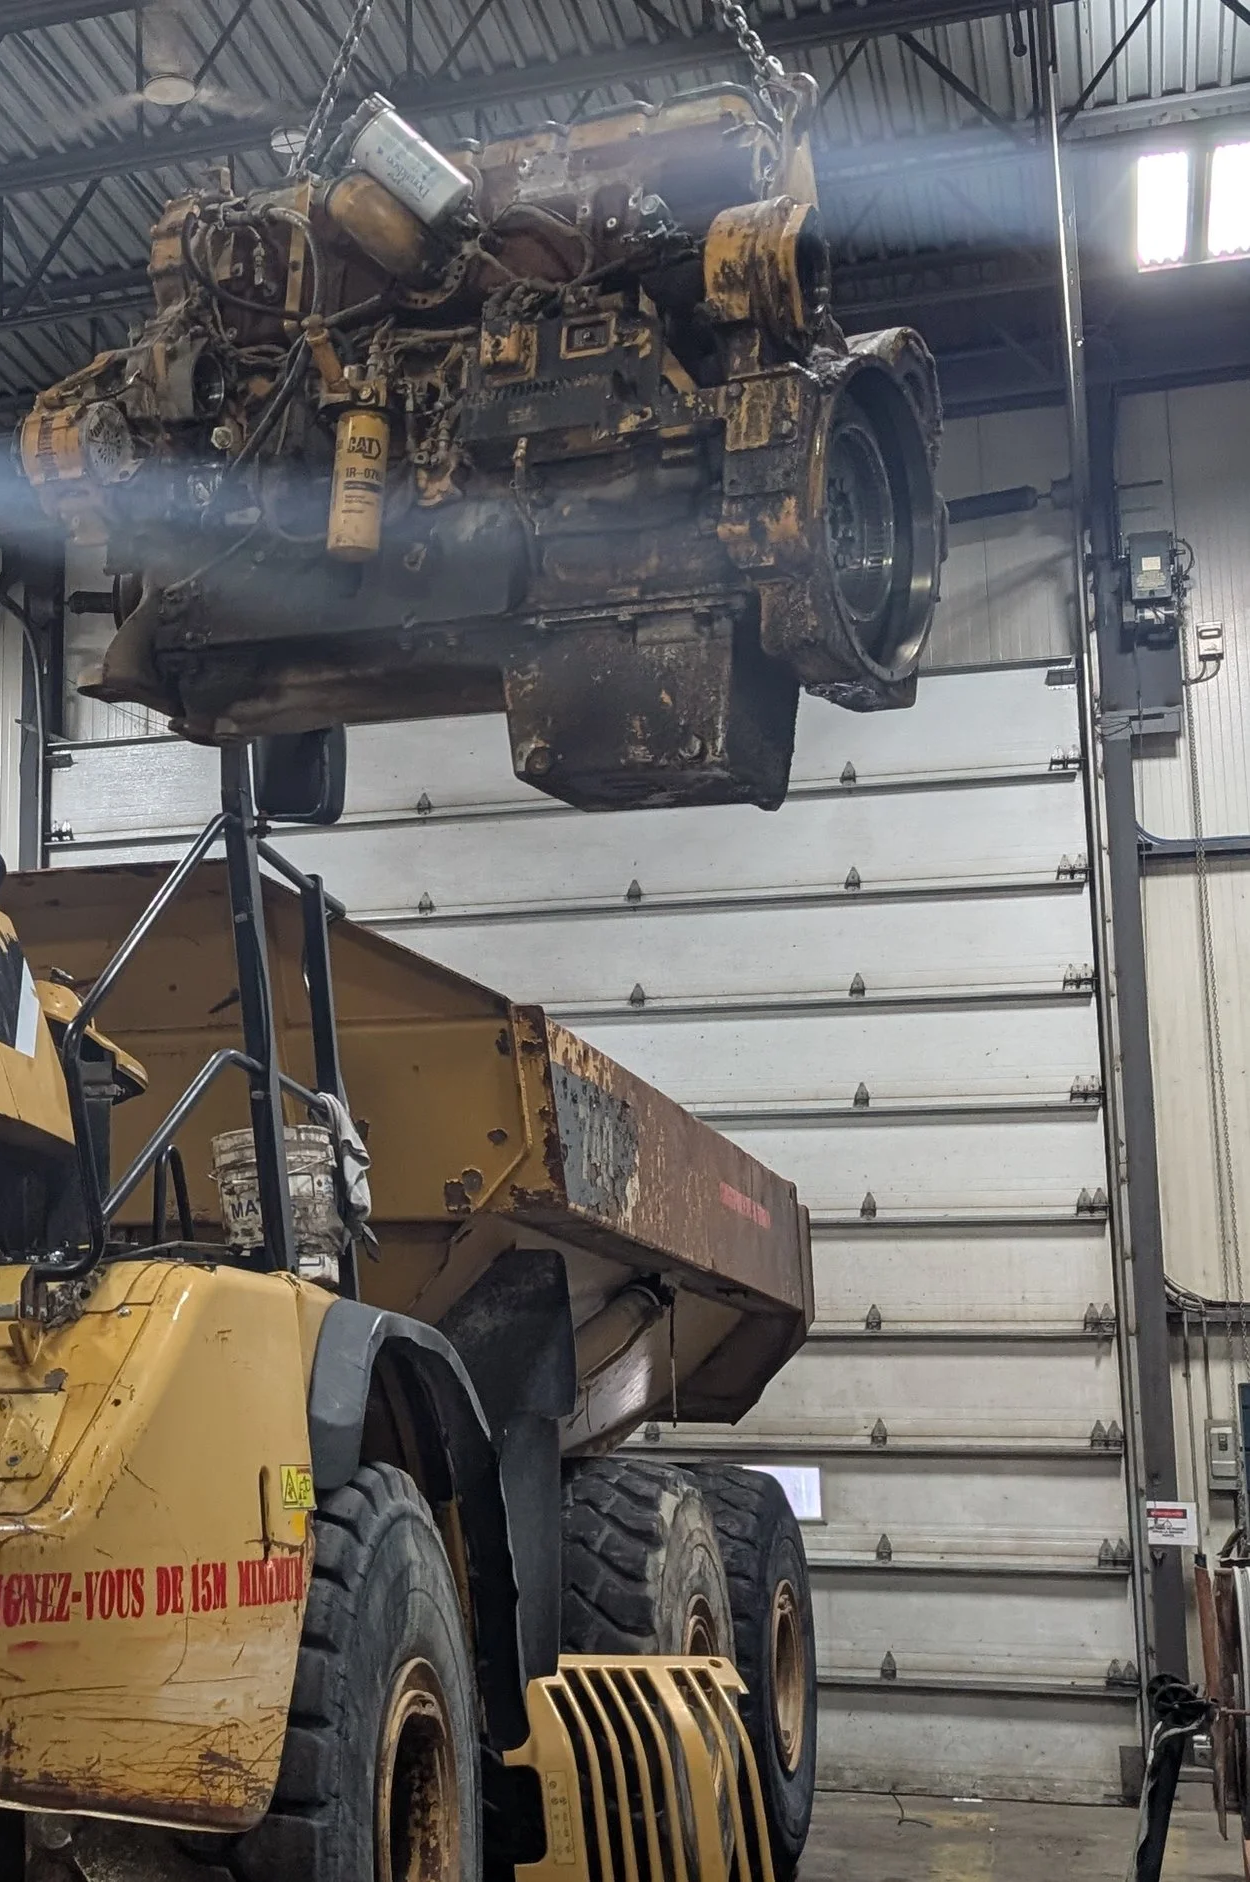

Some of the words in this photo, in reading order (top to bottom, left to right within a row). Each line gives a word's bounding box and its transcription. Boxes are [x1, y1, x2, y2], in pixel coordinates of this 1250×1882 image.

[347, 436, 381, 459] CAT
[156, 1564, 184, 1616] DE
[191, 1562, 227, 1612] 15M
